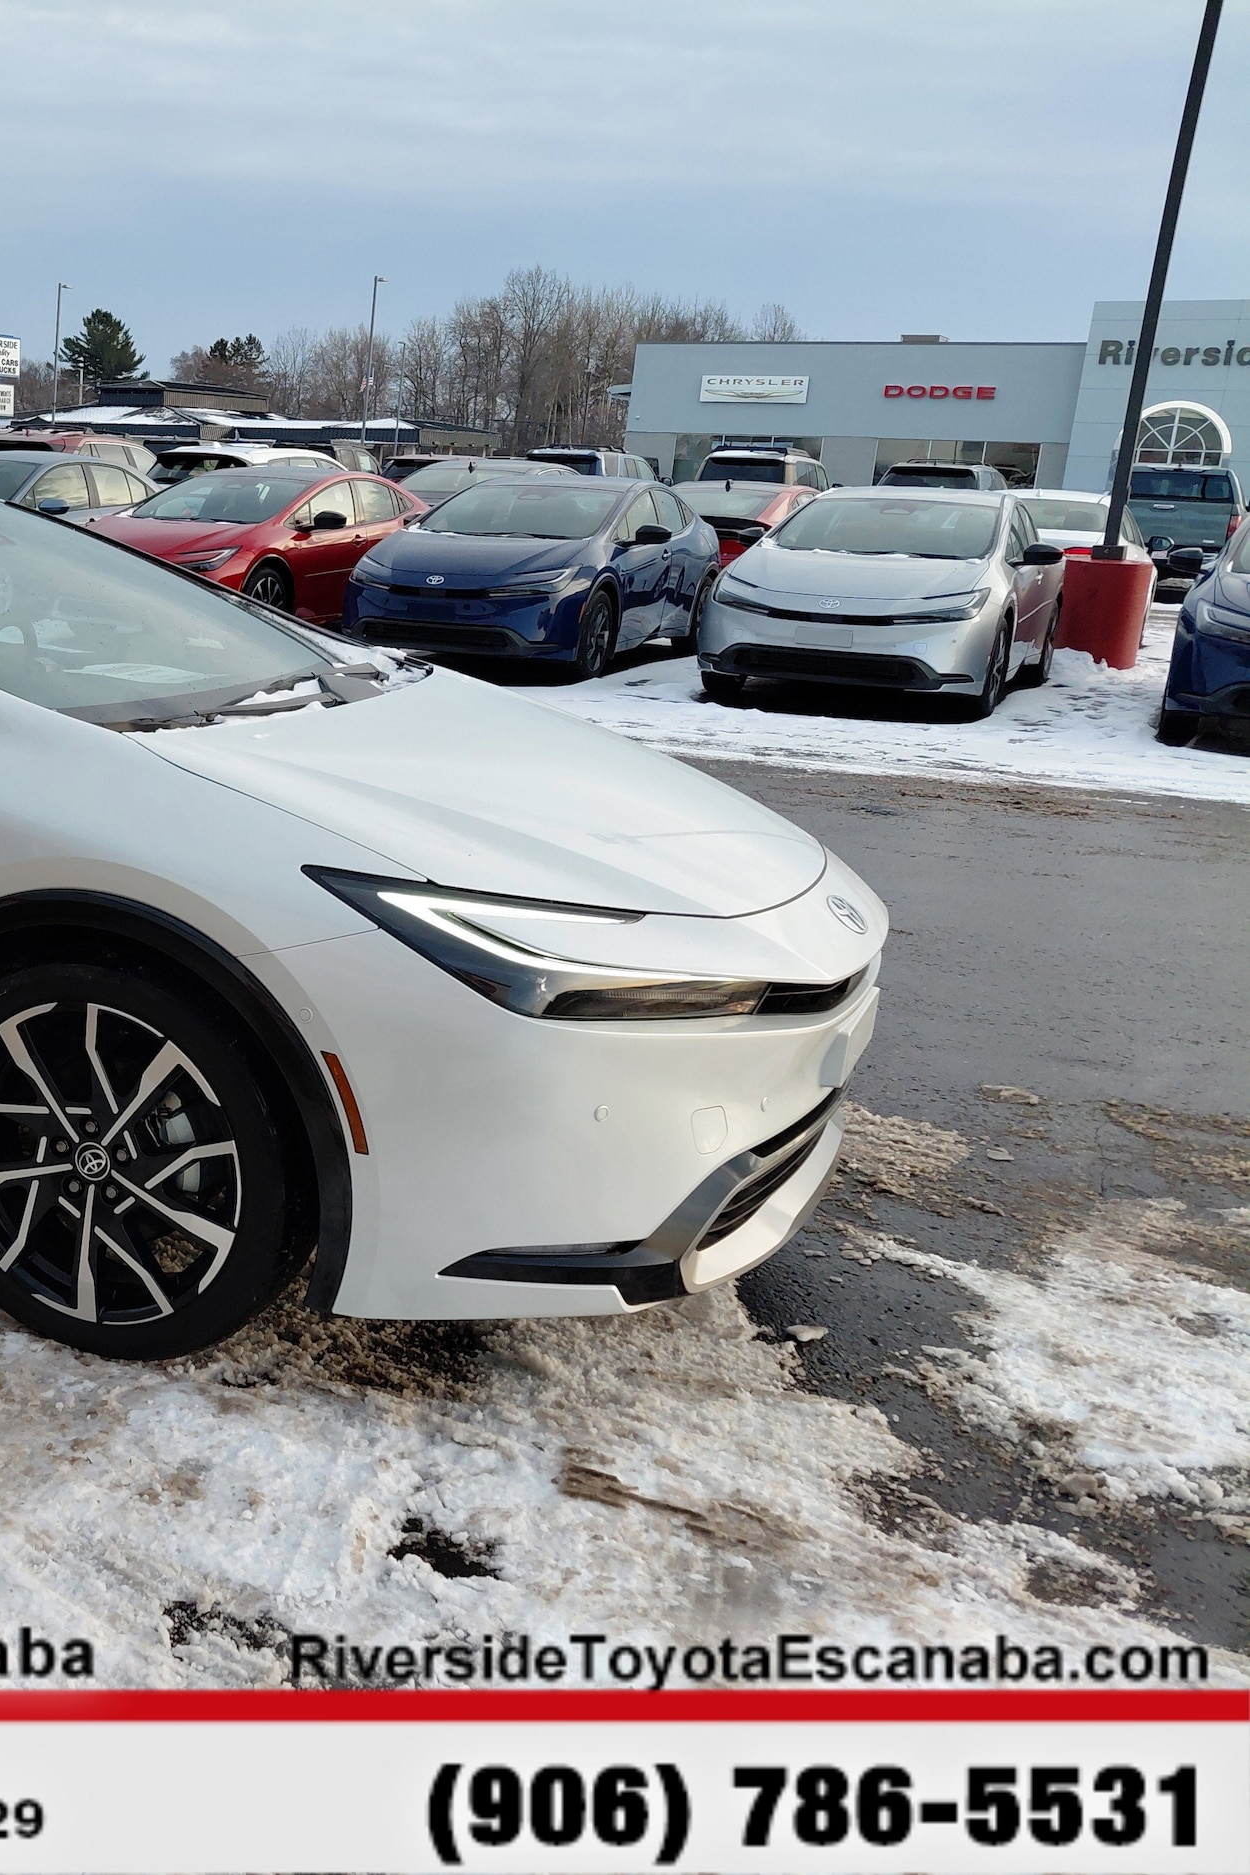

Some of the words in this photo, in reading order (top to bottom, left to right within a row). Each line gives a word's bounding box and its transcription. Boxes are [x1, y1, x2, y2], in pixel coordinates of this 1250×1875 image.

[1, 358, 18, 367] CARS
[707, 378, 804, 386] CHRYSLER
[883, 384, 996, 400] DODGE
